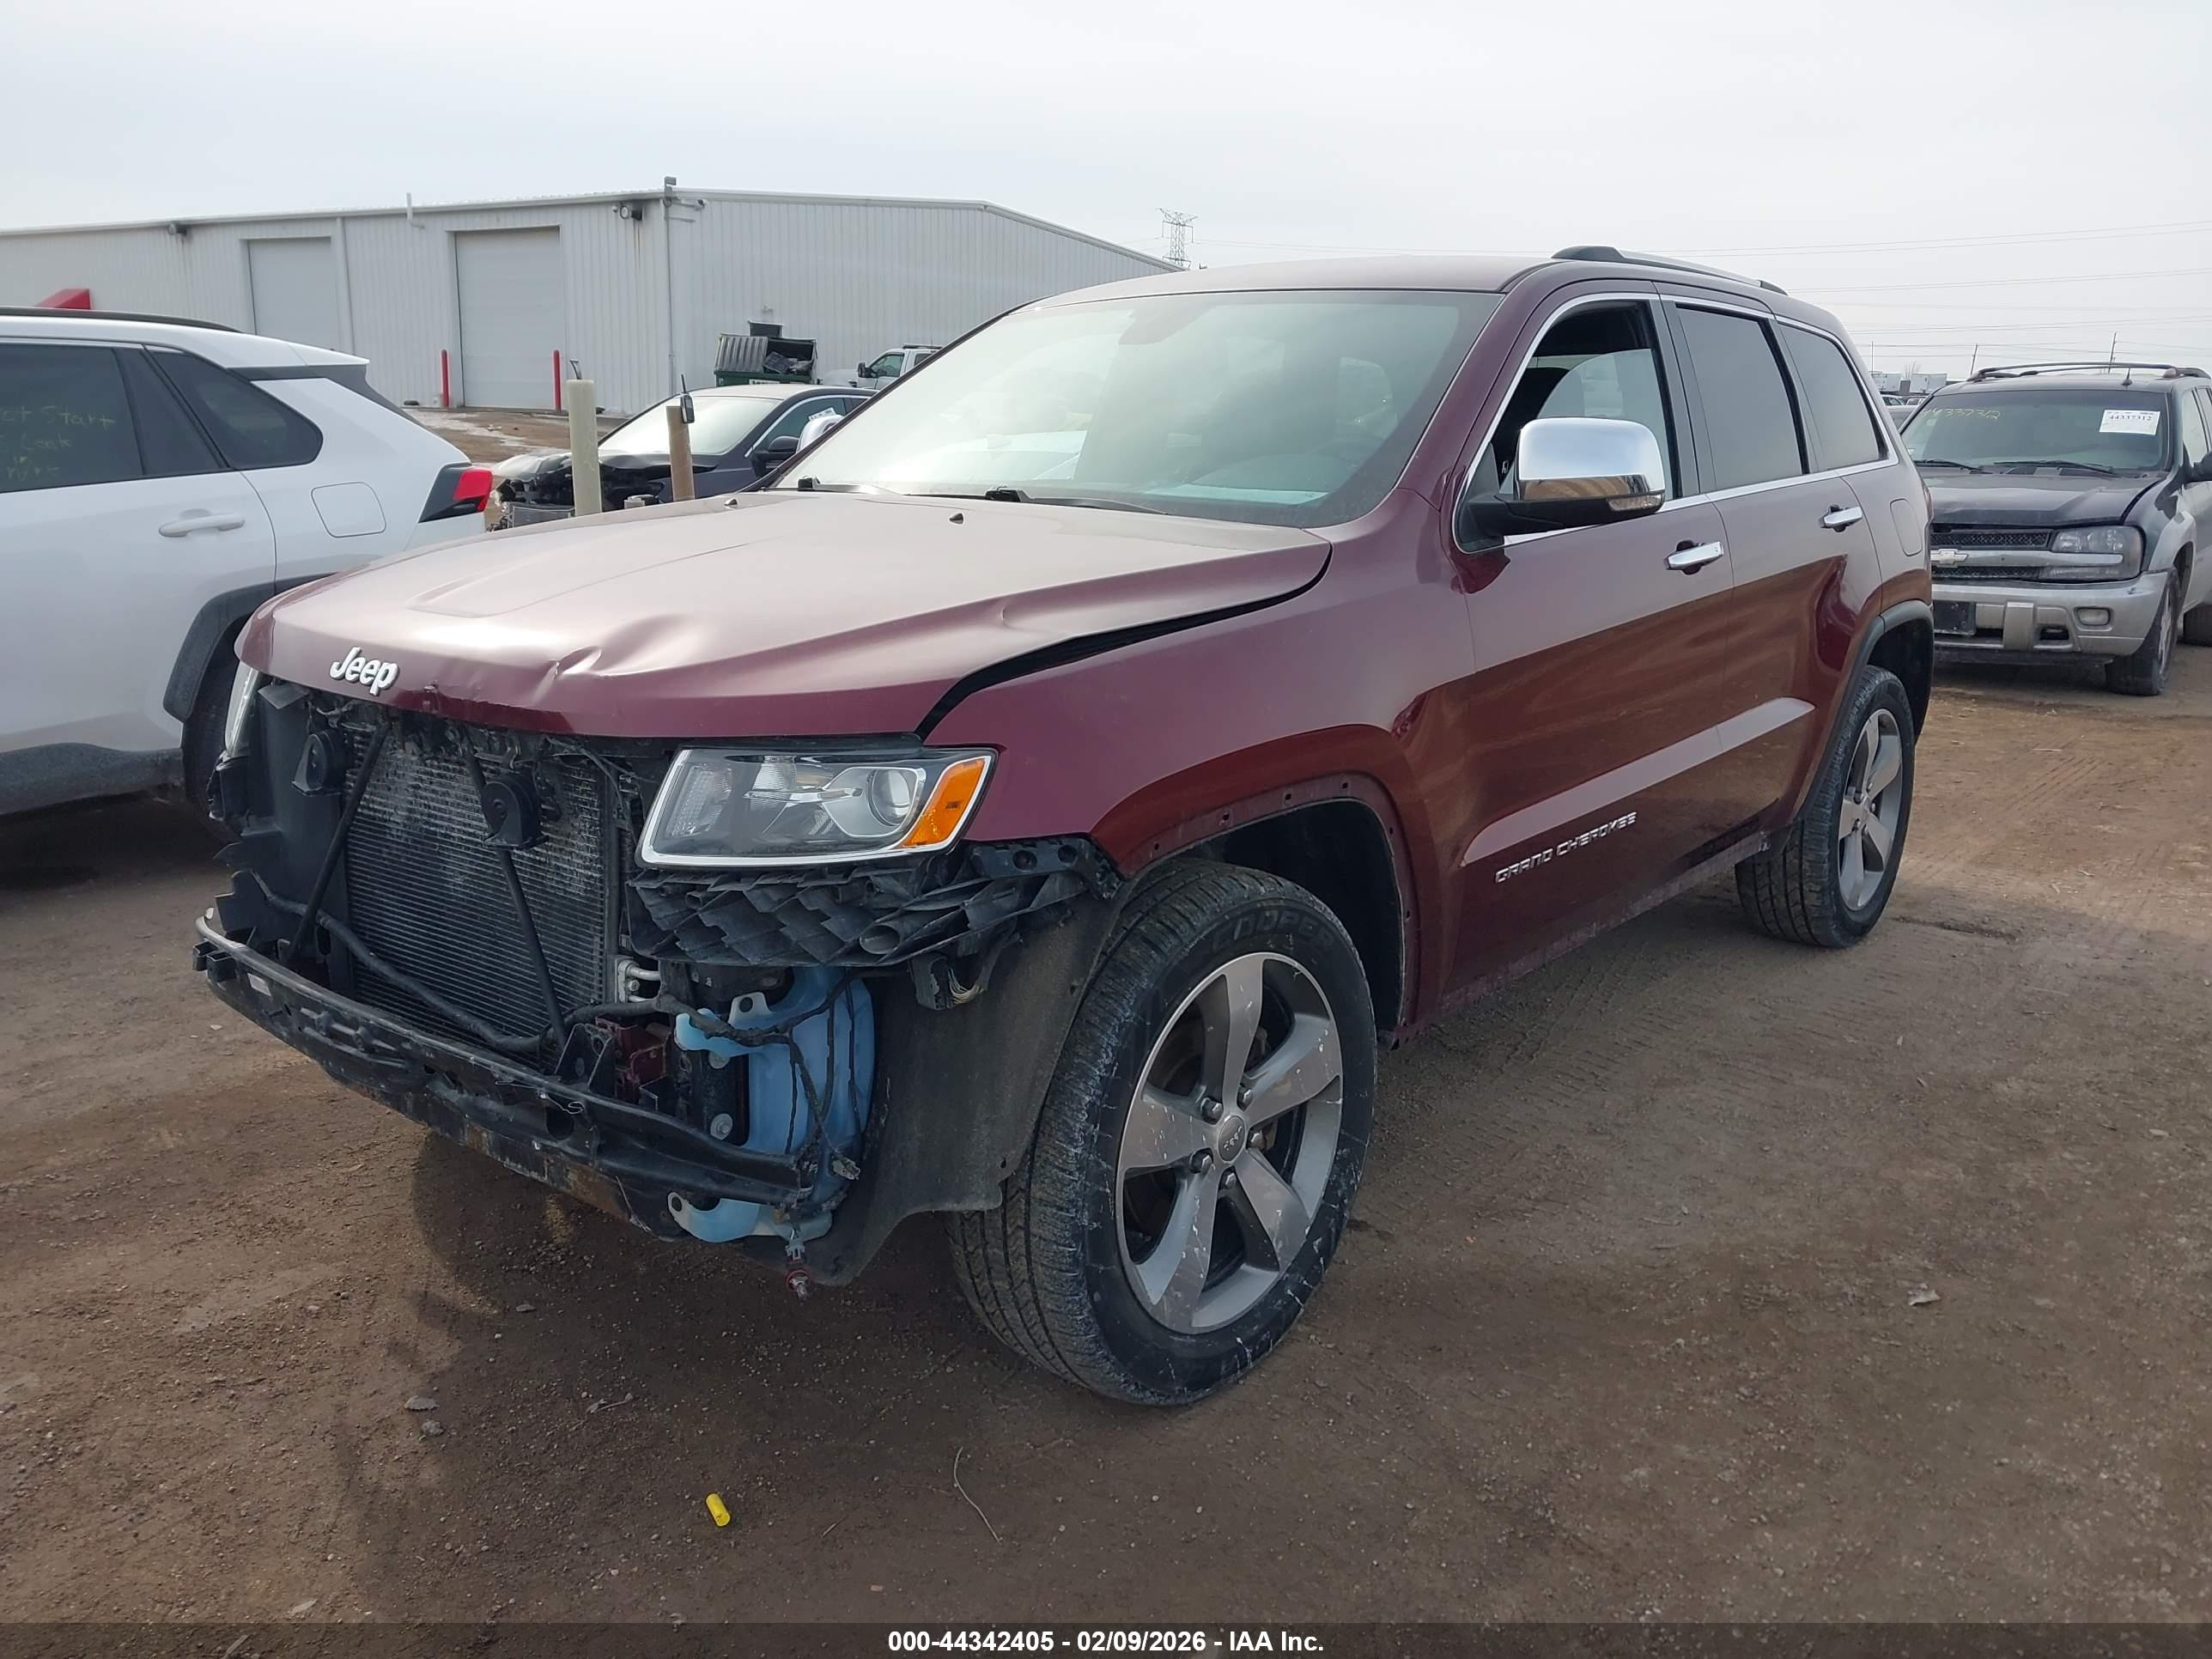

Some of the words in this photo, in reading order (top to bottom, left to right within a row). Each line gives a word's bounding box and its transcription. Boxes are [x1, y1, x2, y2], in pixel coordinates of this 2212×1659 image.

[330, 647, 399, 696] Jeep
[1495, 848, 1553, 884] GRAND
[1556, 811, 1638, 856] CHEROKEE
